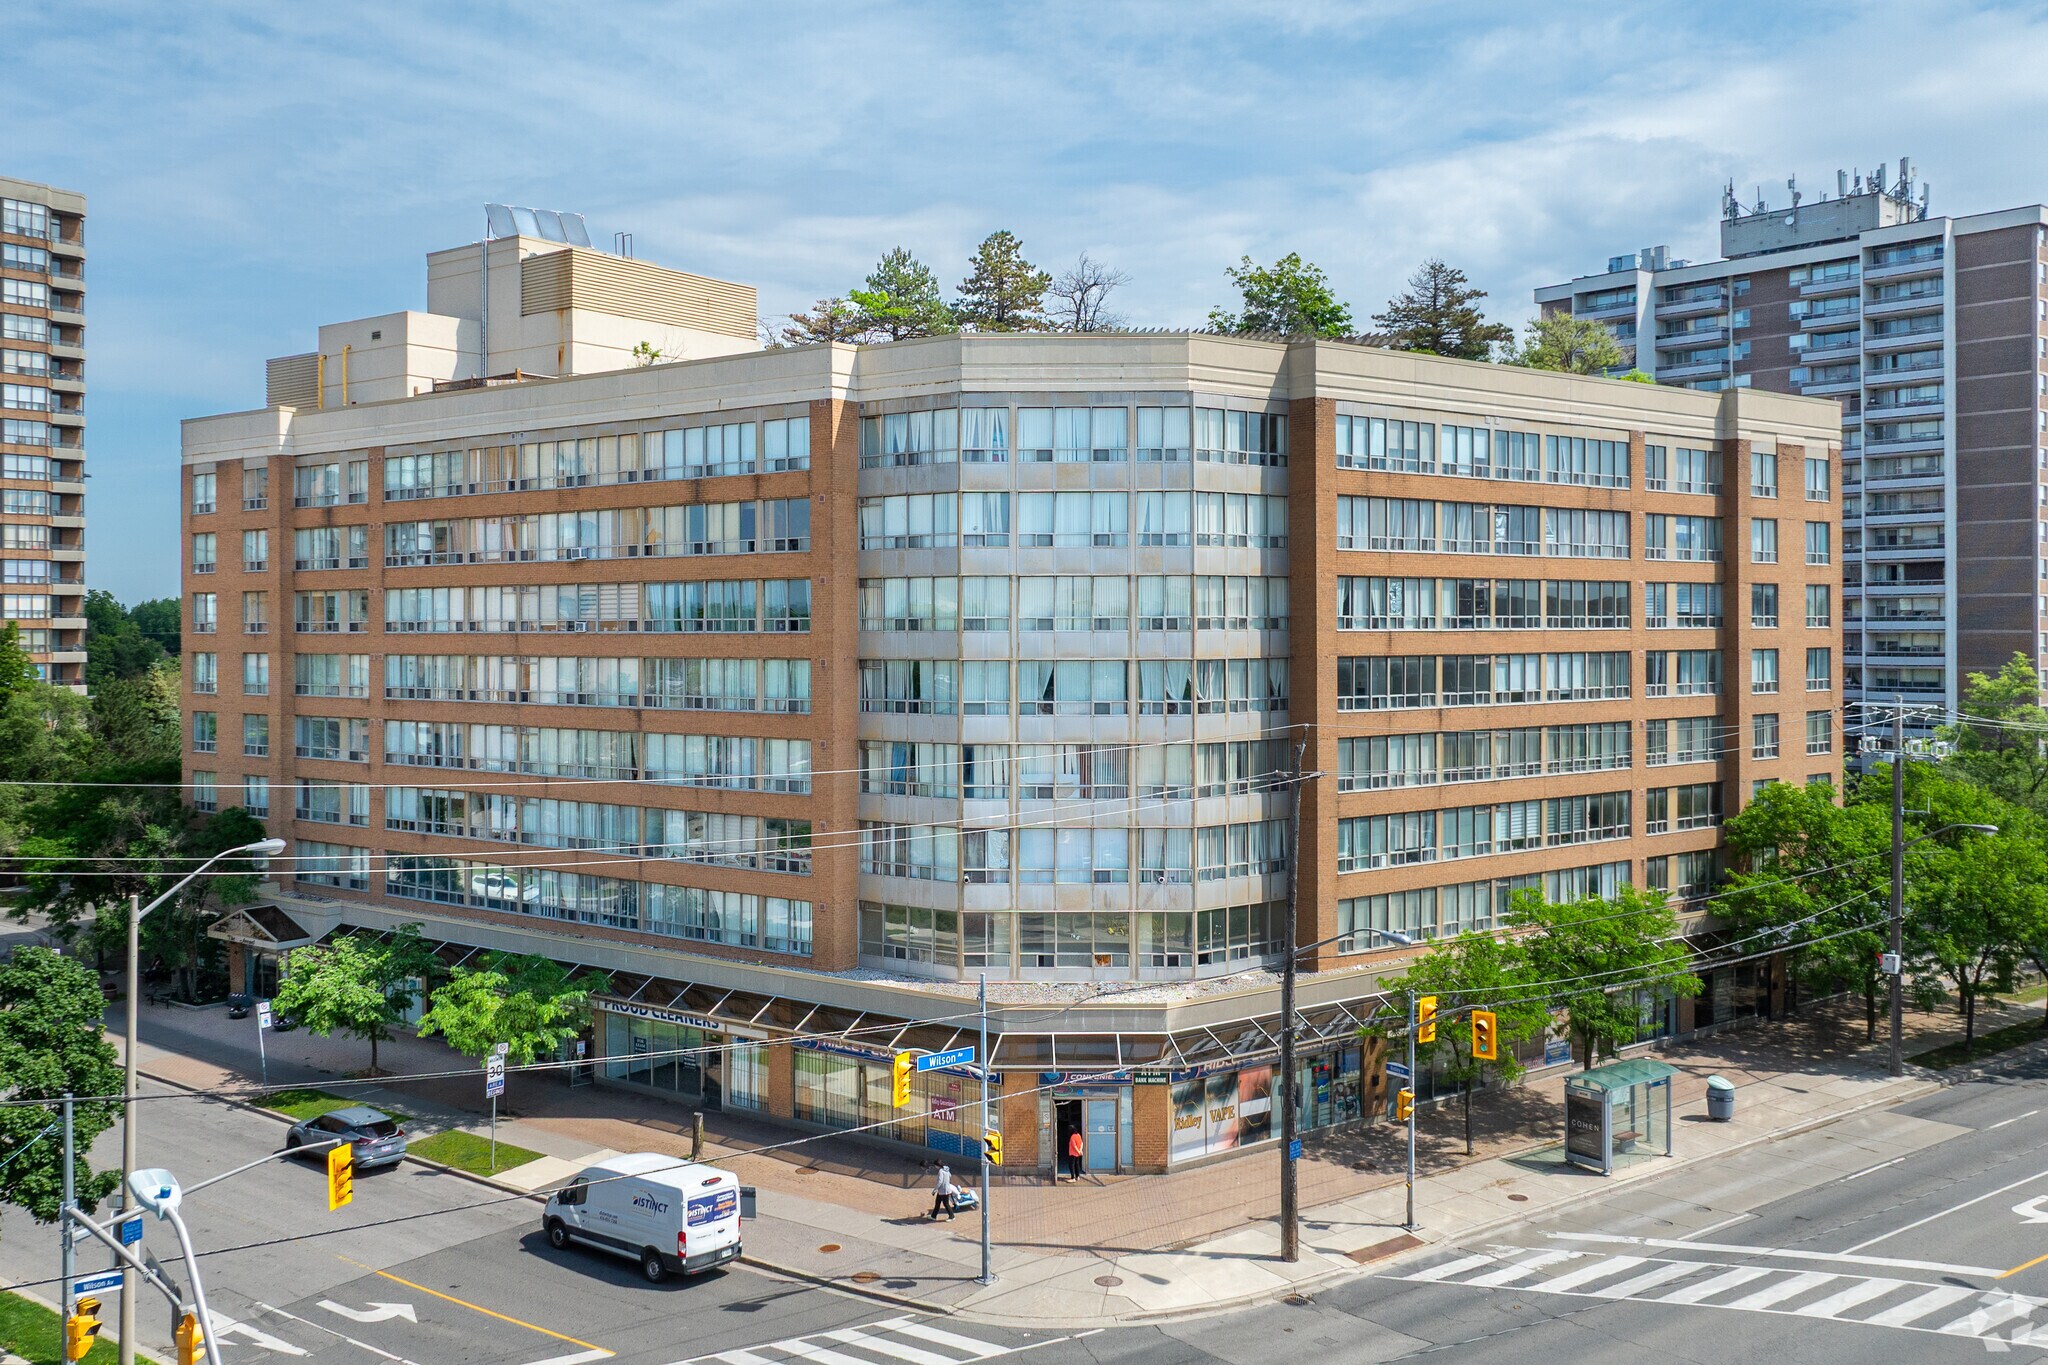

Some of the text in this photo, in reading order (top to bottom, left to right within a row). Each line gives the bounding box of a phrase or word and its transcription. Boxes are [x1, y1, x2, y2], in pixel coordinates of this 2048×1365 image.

[928, 1054, 956, 1067] Wilson
[489, 1064, 503, 1078] 30
[933, 1109, 955, 1121] ATM
[1174, 1104, 1235, 1131] Ridley VAPE
[1571, 1119, 1600, 1132] COHEN
[632, 1195, 669, 1214] DISTINCT
[83, 1281, 106, 1291] Wilson
